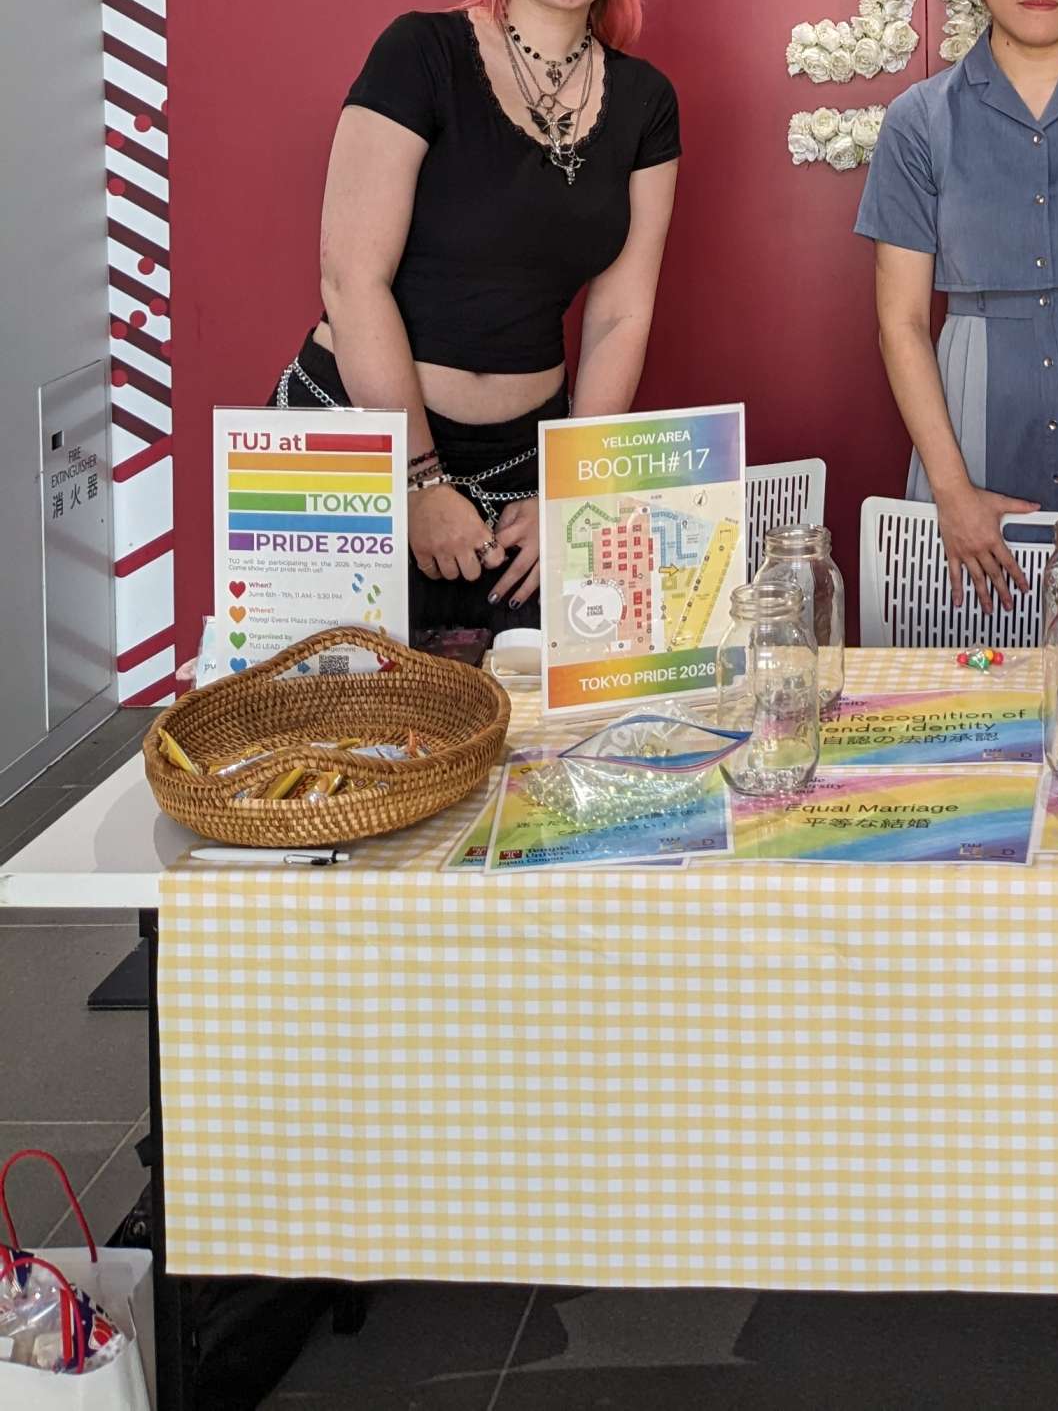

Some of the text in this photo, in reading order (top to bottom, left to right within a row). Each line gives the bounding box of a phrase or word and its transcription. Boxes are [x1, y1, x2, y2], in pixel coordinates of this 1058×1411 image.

[228, 432, 302, 451] TUJ at
[602, 430, 691, 448] YELLOW AREA
[68, 446, 82, 463] FIRE
[51, 453, 97, 488] EXTINGUISHER
[52, 473, 98, 519] 消火器
[308, 493, 392, 514] TOKYO
[256, 533, 394, 555] PRIDE 2026
[579, 663, 716, 692] TOKYO PRIDE 2026
[851, 711, 993, 724] Recognition
[1002, 709, 1027, 719] of
[819, 721, 996, 734] ender Identity
[823, 732, 1000, 746] 自認の法的承認
[785, 803, 959, 815] Equal Marriage
[801, 818, 932, 829] 平等な結婚
